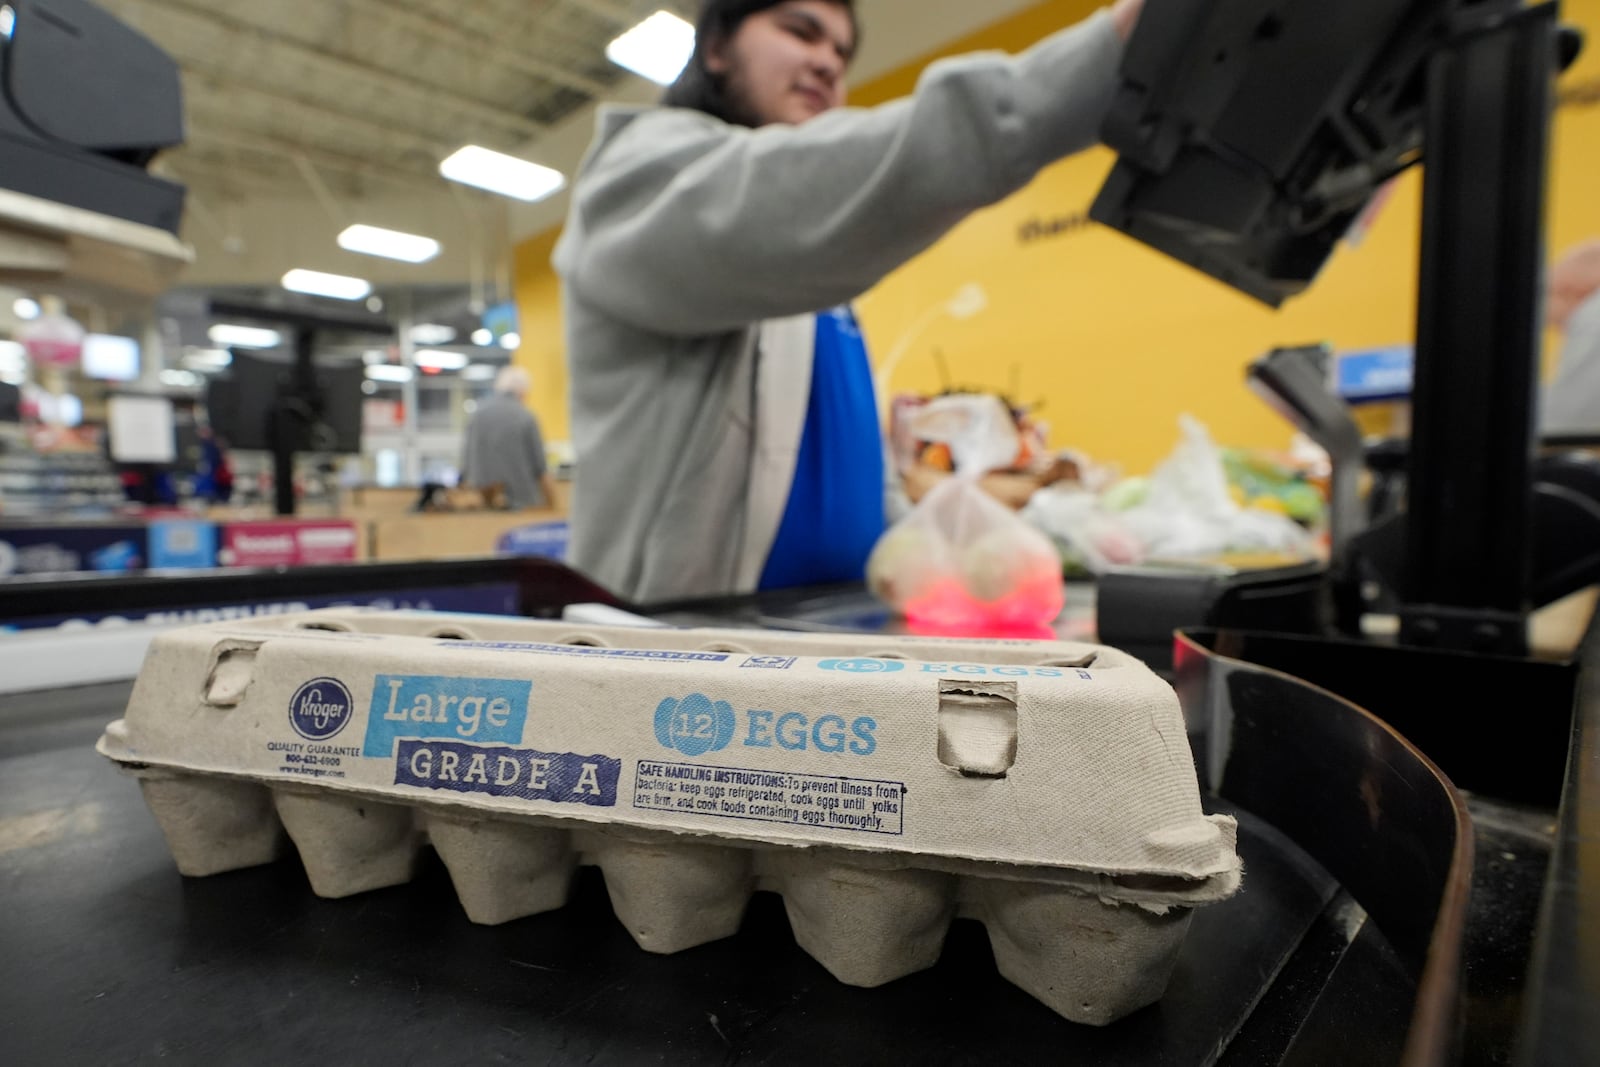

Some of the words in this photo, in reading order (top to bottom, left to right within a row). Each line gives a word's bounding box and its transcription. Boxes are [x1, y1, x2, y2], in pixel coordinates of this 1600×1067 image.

[622, 650, 714, 660] PROTEIN
[843, 661, 882, 671] 12
[919, 663, 1063, 678] EGGS
[300, 688, 344, 730] Kroger
[383, 680, 511, 736] Large
[267, 742, 305, 753] QUALITY
[306, 744, 361, 758] GUARANTEE
[675, 713, 713, 738] 12
[743, 709, 877, 755] EGGS
[278, 764, 346, 778] www.kroger.com
[410, 748, 551, 790] GRADE
[573, 762, 602, 796] A
[640, 763, 663, 777] SAFE
[665, 766, 712, 781] HANDLING
[801, 781, 838, 793] prevent
[876, 784, 899, 799] from
[636, 793, 651, 804] are
[654, 792, 674, 808] firm,
[677, 796, 694, 809] and
[696, 799, 718, 811] cook
[720, 799, 746, 814] foods
[749, 803, 799, 822] containing
[802, 809, 825, 824] eggs
[829, 810, 885, 830] thoroughly.
[638, 778, 677, 792] bacteria:
[679, 781, 701, 796] keep
[704, 785, 725, 799] eggs
[728, 786, 787, 804] refrigerated,
[790, 793, 813, 806] cook
[816, 796, 839, 810] eggs
[843, 797, 865, 811] until
[872, 800, 898, 814] yolks
